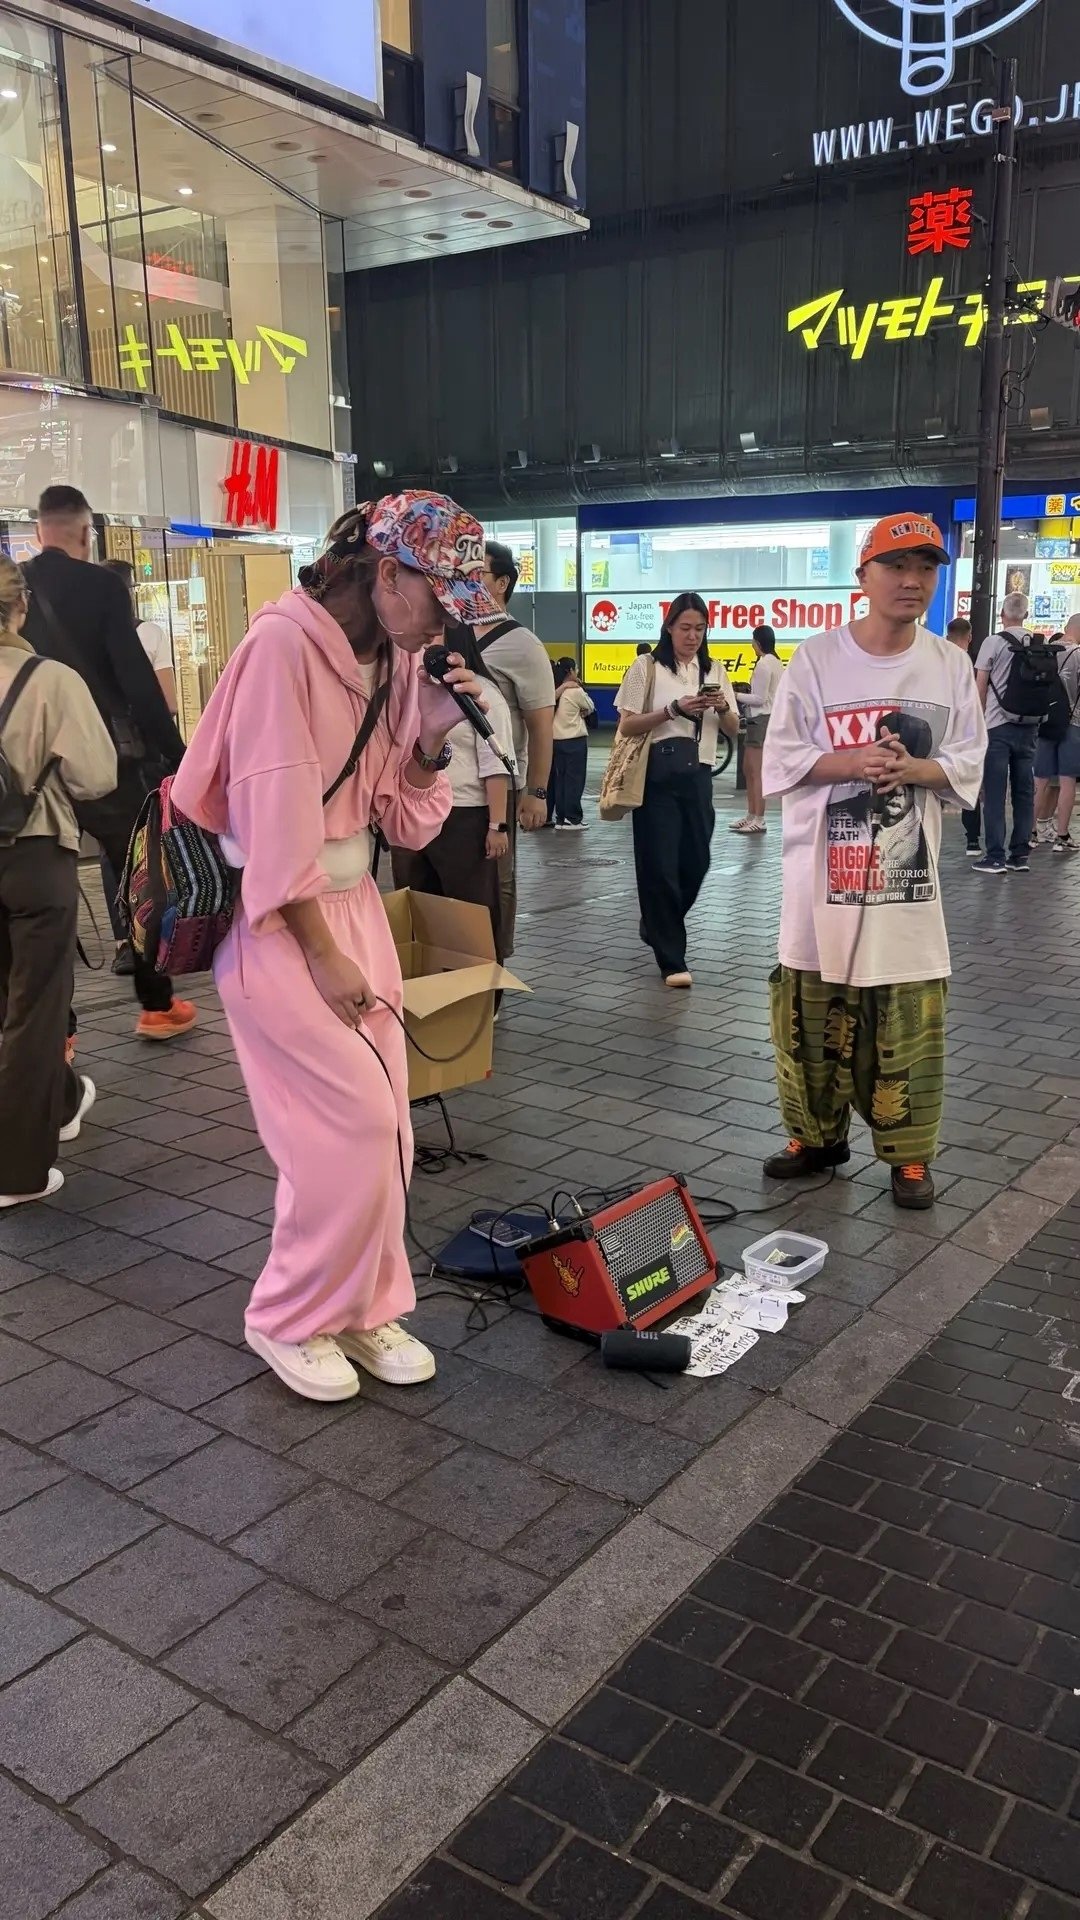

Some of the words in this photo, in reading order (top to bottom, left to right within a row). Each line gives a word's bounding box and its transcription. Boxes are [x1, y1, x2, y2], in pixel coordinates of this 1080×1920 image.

[908, 187, 973, 255] 薬
[890, 522, 912, 538] NEW
[771, 598, 843, 630] Shop
[635, 621, 654, 631] Shop
[828, 710, 893, 746] XX
[830, 819, 860, 828] AFTER
[828, 831, 859, 841] DEATH
[830, 869, 886, 891] SMALLS
[888, 869, 929, 878] OTORIOU
[831, 893, 844, 902] THE
[885, 892, 906, 900] YORK
[626, 1266, 671, 1301] SHURE
